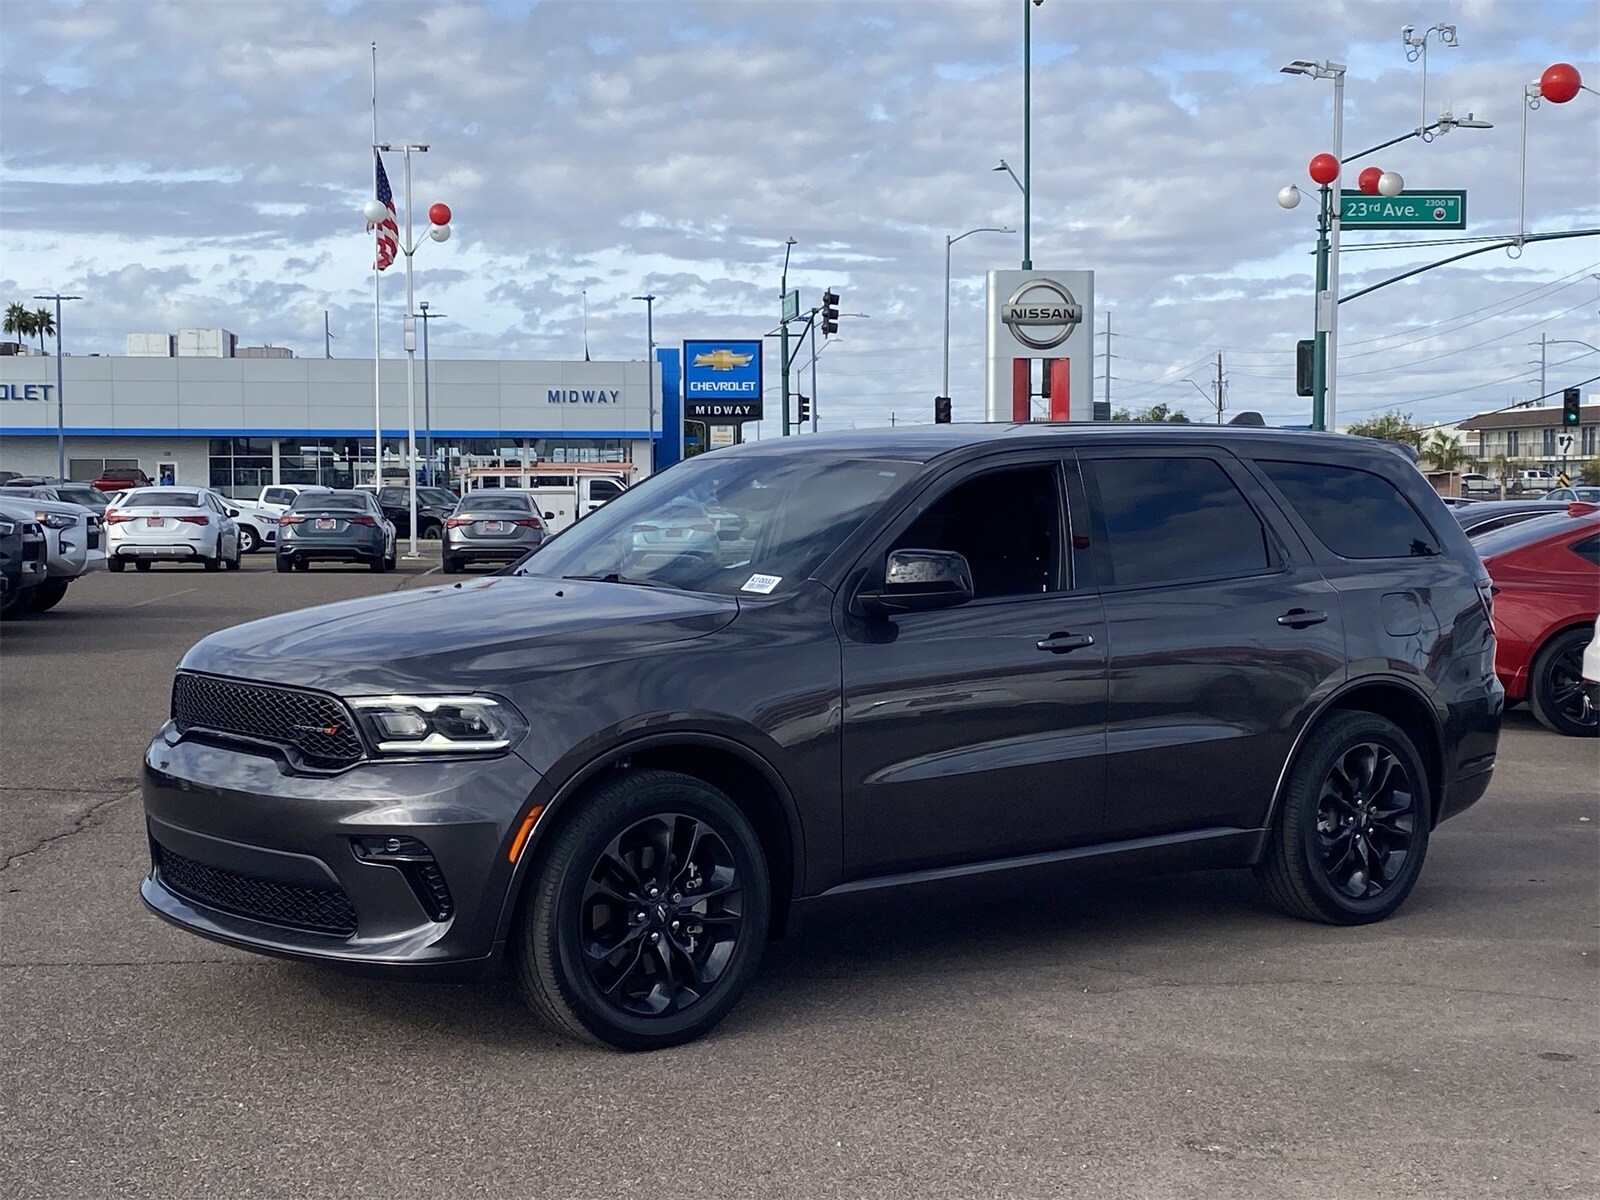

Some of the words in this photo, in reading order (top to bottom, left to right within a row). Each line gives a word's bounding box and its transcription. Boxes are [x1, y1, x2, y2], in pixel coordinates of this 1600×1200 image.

[1425, 199, 1446, 207] 2300
[1346, 202, 1381, 217] 23rd
[1382, 203, 1419, 217] Ave.
[1010, 308, 1075, 319] NISSAN
[690, 381, 756, 391] CHEVROLET
[547, 390, 619, 403] MIDWAY
[695, 405, 750, 415] MIDWAY
